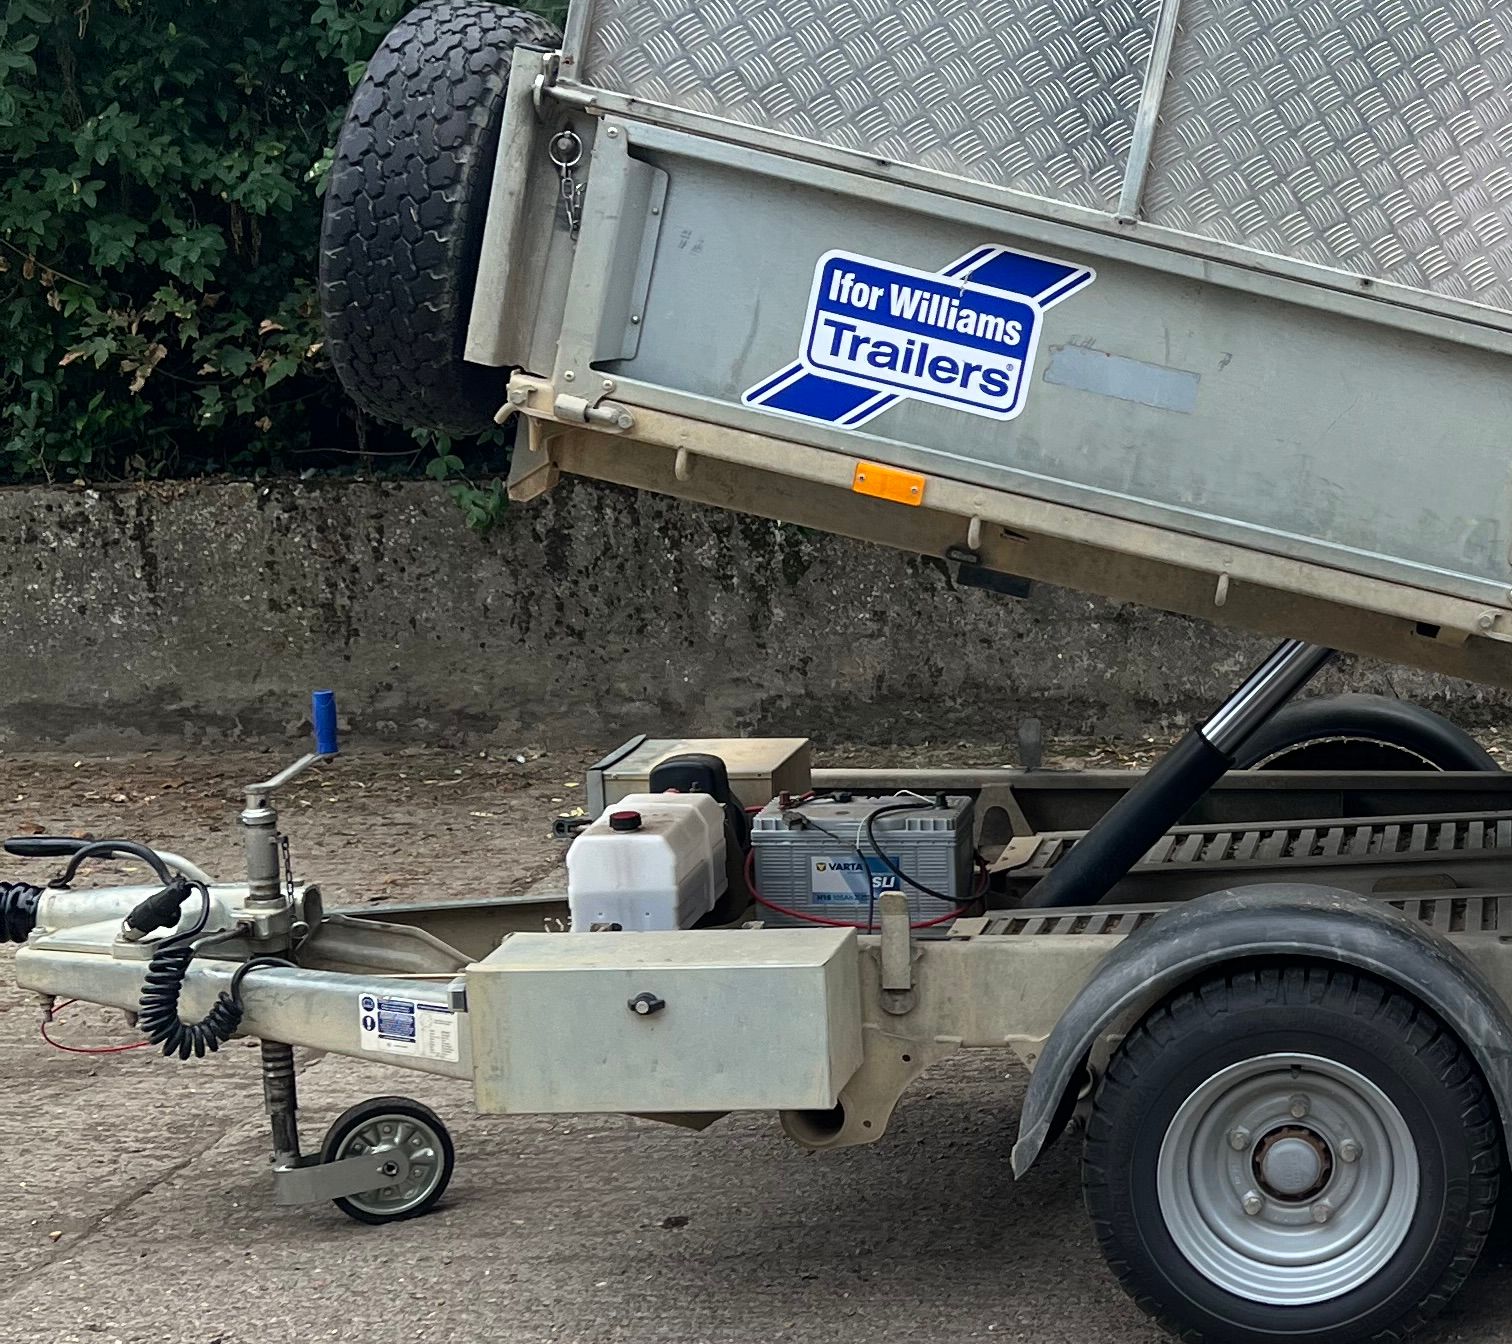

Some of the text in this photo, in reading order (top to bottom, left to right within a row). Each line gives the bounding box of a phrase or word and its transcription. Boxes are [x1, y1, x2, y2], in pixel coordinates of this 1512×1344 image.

[828, 268, 1023, 346] Ifor Williams
[823, 318, 1011, 397] Trailers
[829, 862, 864, 871] VARTA
[872, 876, 896, 888] SLI
